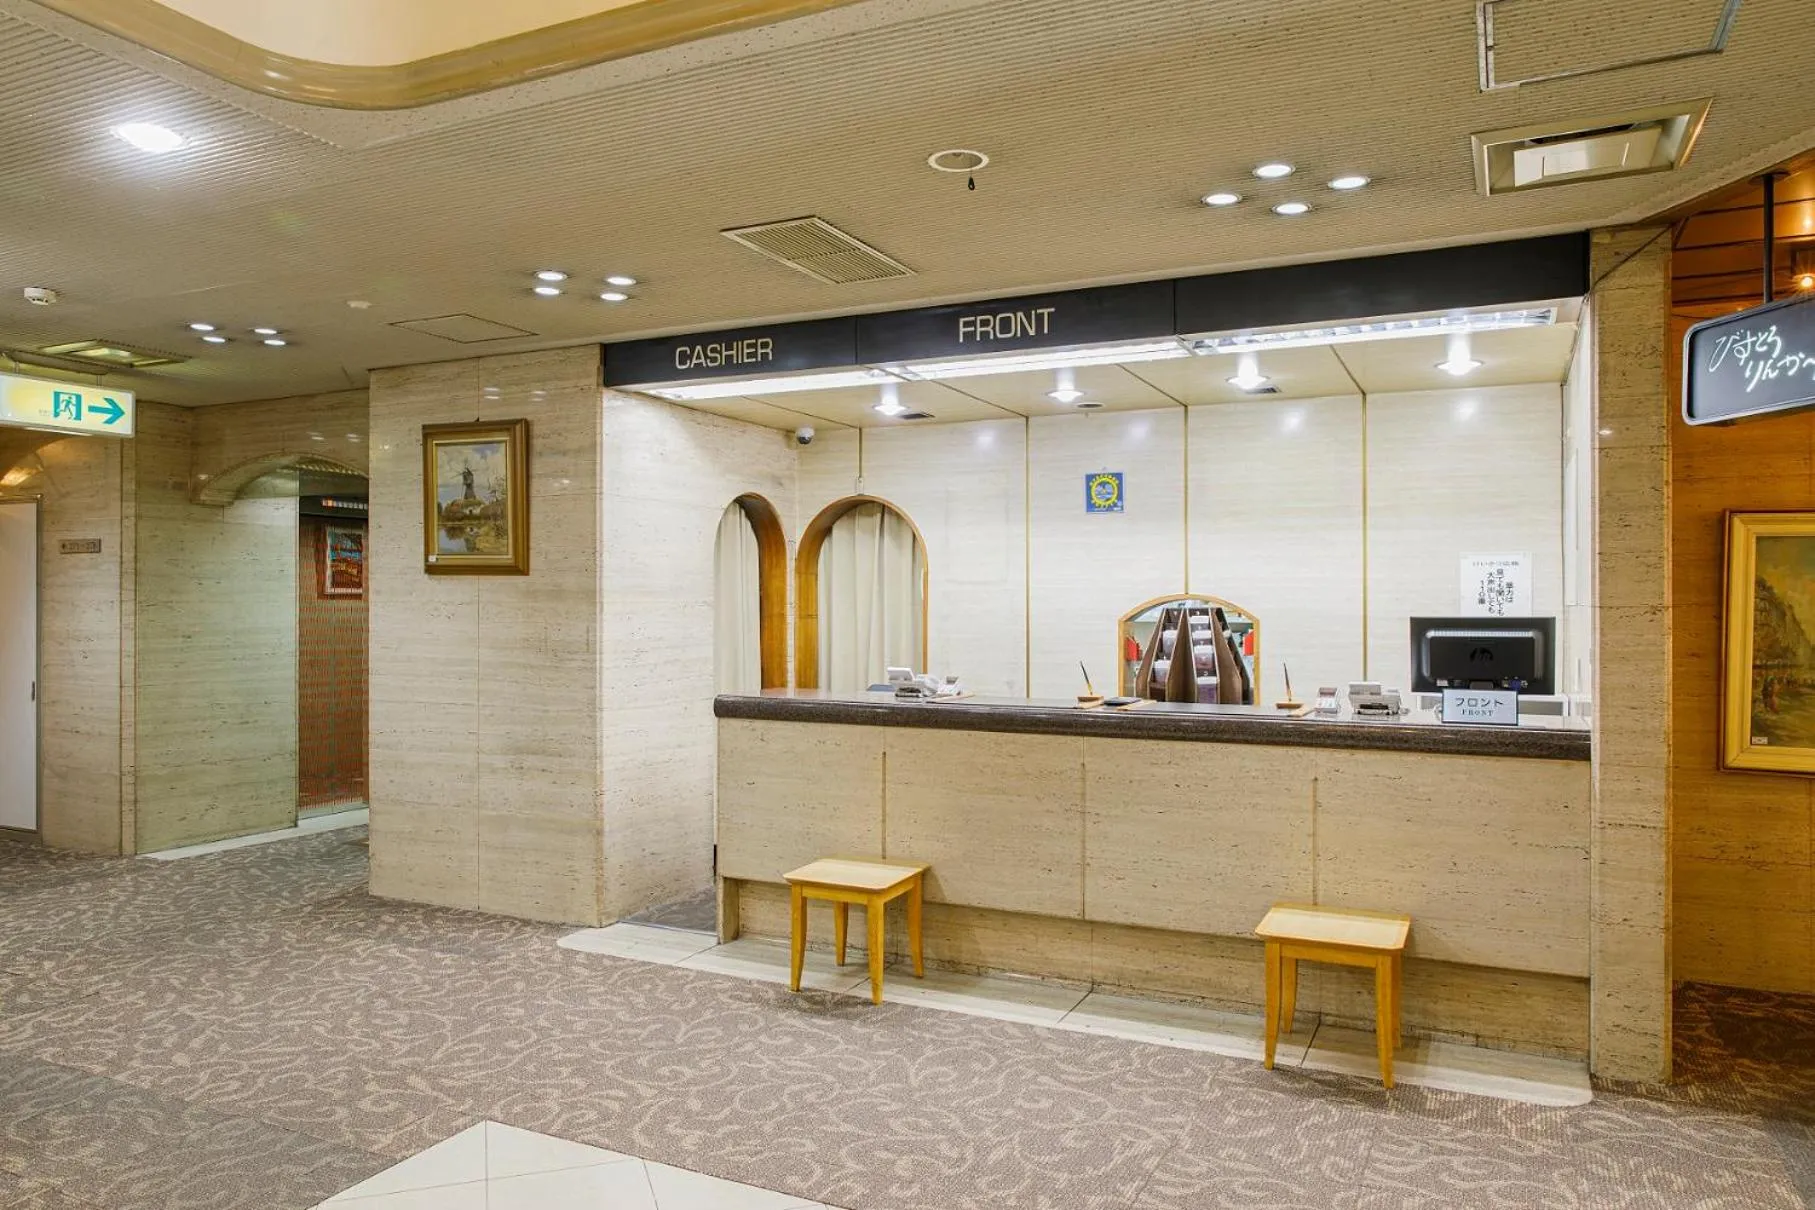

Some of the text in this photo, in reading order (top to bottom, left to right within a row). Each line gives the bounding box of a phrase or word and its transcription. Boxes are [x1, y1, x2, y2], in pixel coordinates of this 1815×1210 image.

[959, 308, 1055, 342] FRONT
[675, 338, 772, 369] CASHIER
[1708, 326, 1782, 373] びすとろ
[1455, 697, 1504, 708] フロント
[1461, 708, 1494, 717] FRONT
